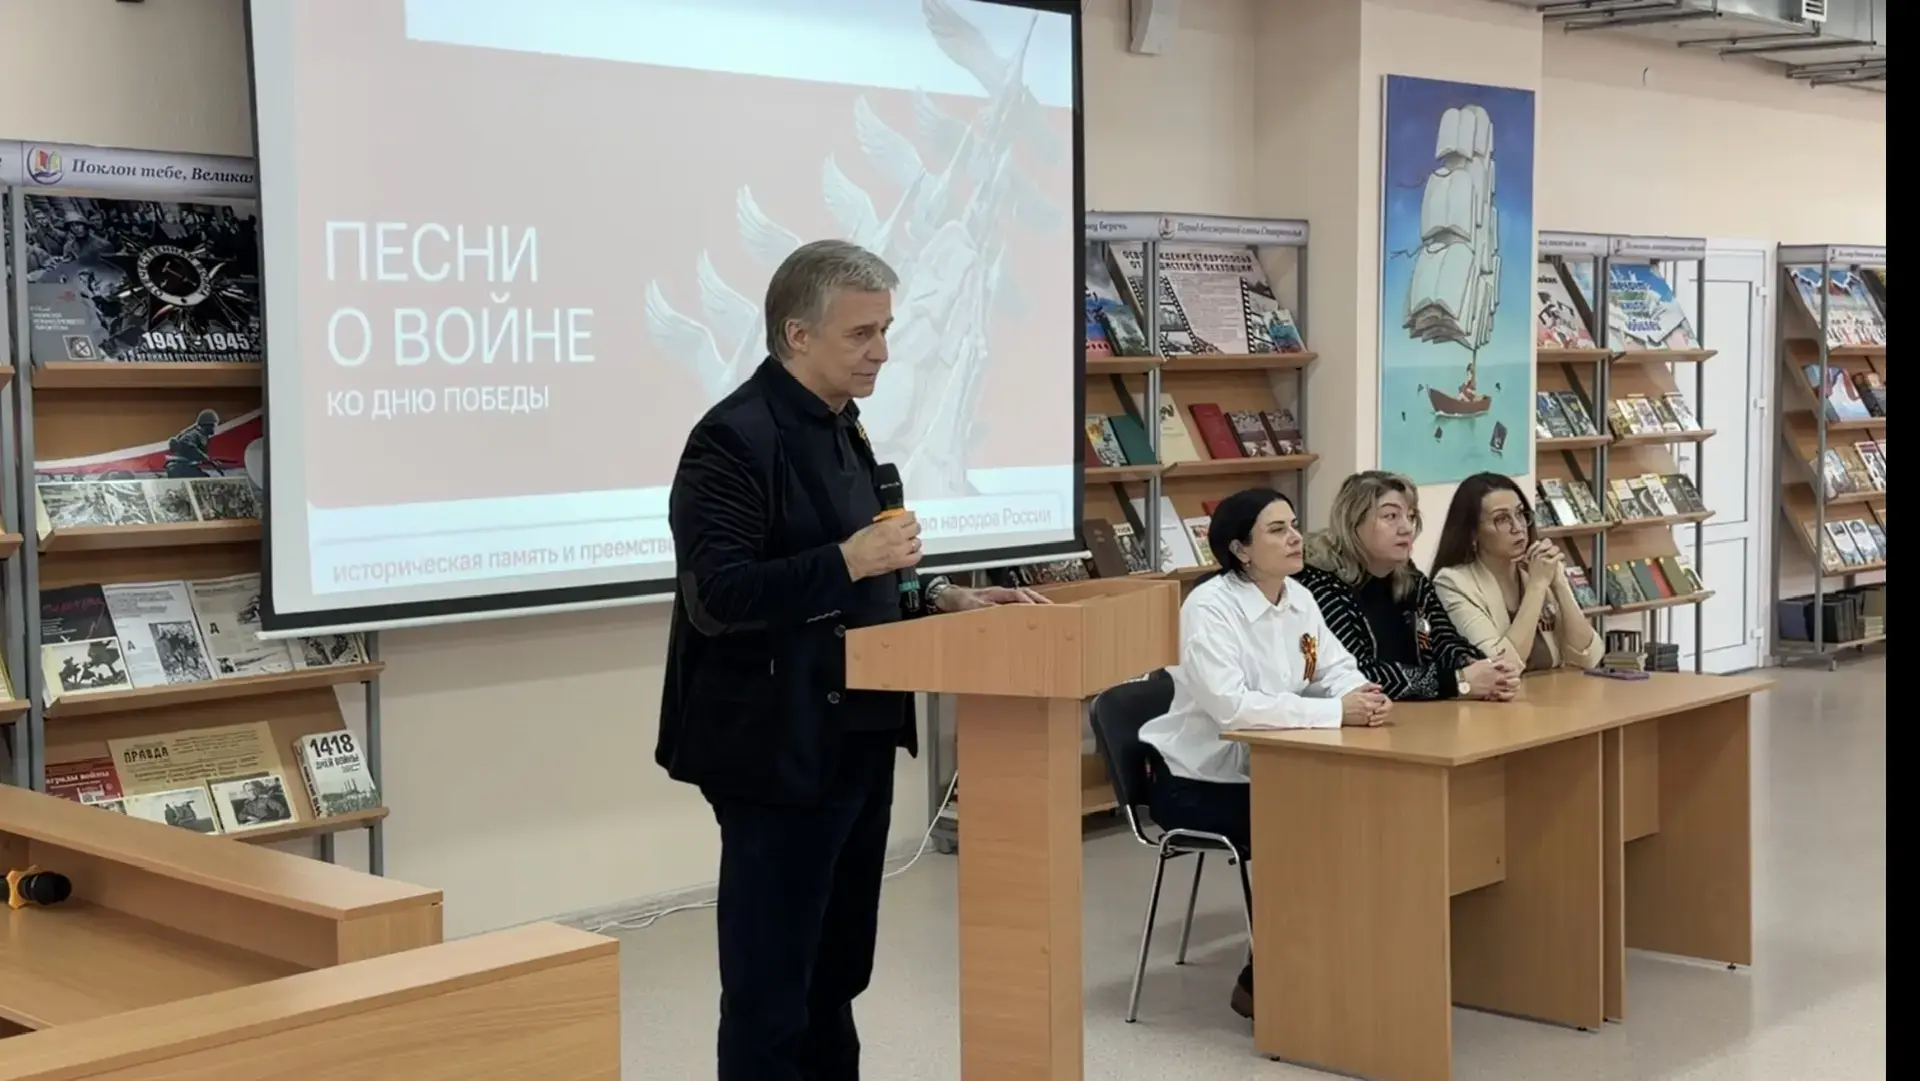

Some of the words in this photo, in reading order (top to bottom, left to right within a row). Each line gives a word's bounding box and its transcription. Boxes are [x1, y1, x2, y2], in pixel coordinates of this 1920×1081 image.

[72, 158, 136, 176] Поклон
[141, 165, 187, 181] тебе,
[325, 220, 538, 282] ПЕСНИ
[142, 331, 187, 350] 1941
[203, 332, 250, 351] 1945
[327, 306, 372, 367] О
[394, 291, 596, 367] ВОЙНЕ
[327, 390, 364, 417] КО
[371, 388, 436, 420] ДНЮ
[444, 385, 549, 414] ПОБЕДЫ
[333, 551, 483, 585] историческая
[488, 545, 559, 570] память
[562, 546, 575, 562] и
[941, 513, 1000, 533] народов
[1003, 507, 1052, 526] России
[123, 746, 169, 764] ПРАВДА
[309, 733, 354, 758] 1418
